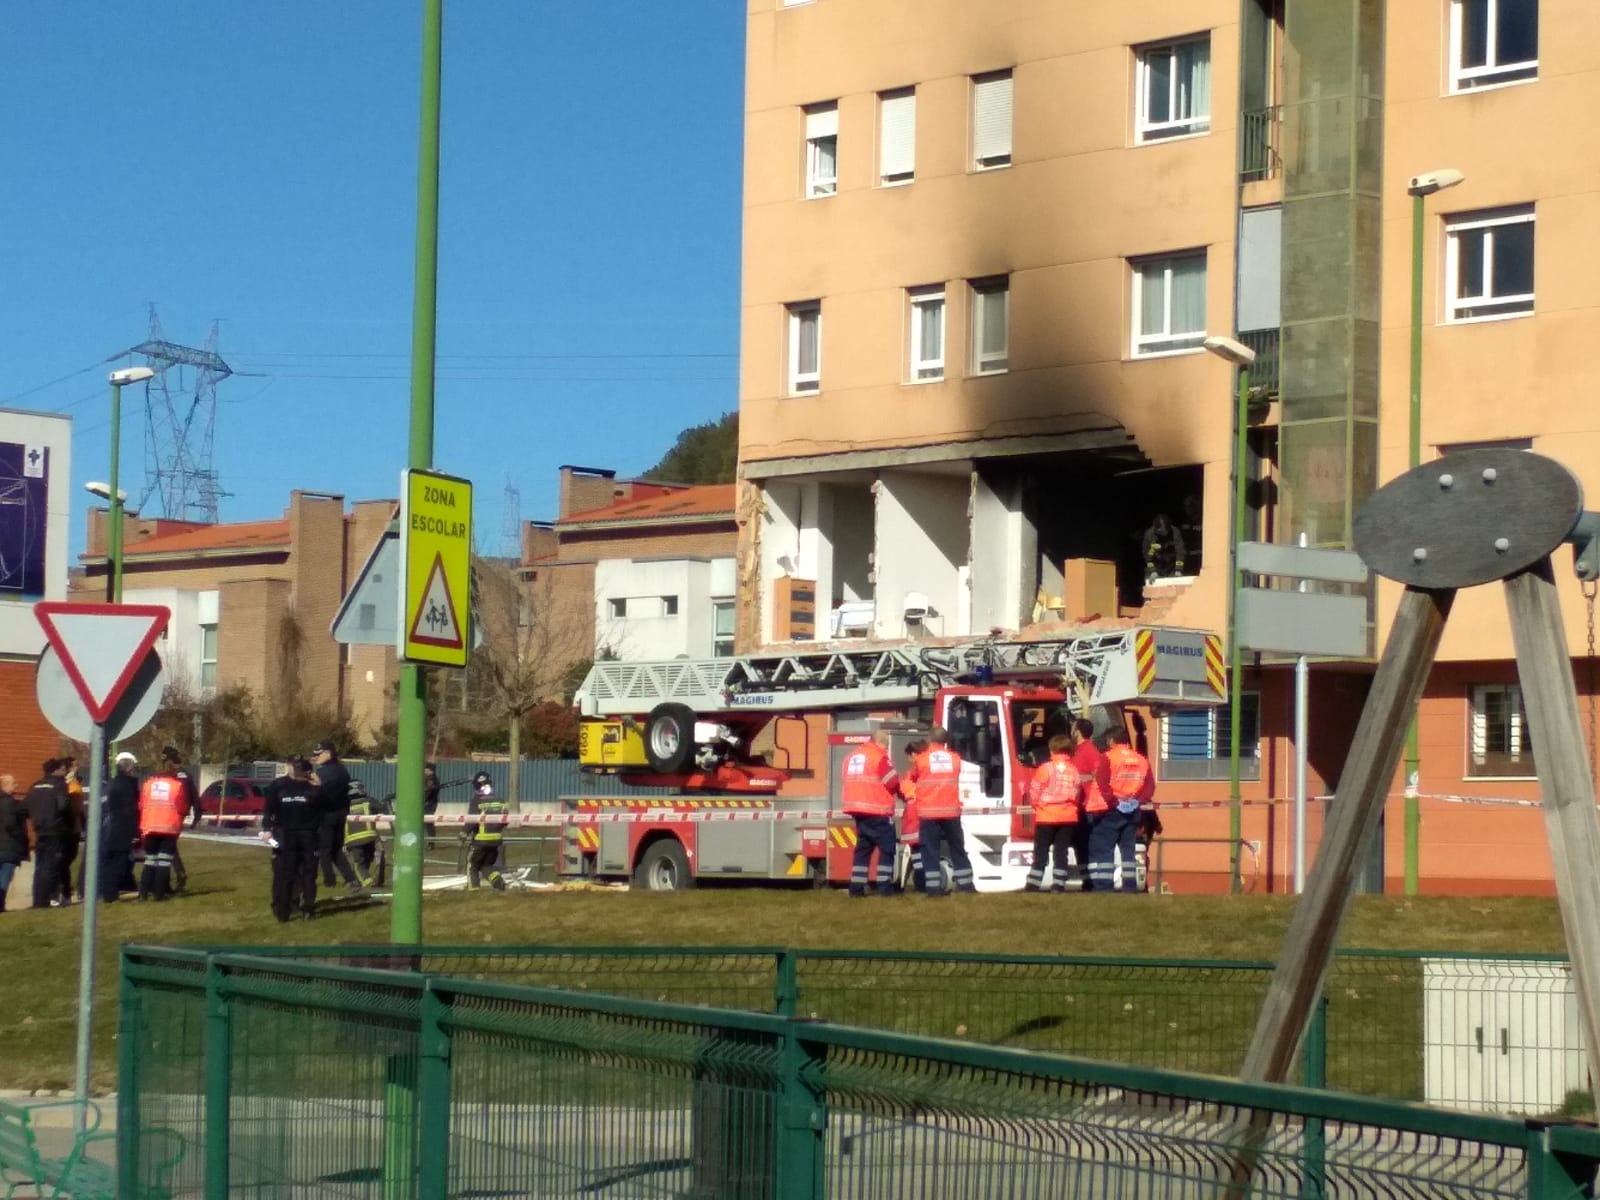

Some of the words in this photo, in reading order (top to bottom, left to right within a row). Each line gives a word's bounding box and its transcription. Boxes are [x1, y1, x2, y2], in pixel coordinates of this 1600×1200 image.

[424, 486, 456, 508] ZONA
[411, 513, 466, 539] ESCOLAR
[1156, 644, 1203, 657] MAGIRUS
[733, 695, 774, 705] MAGIRUS
